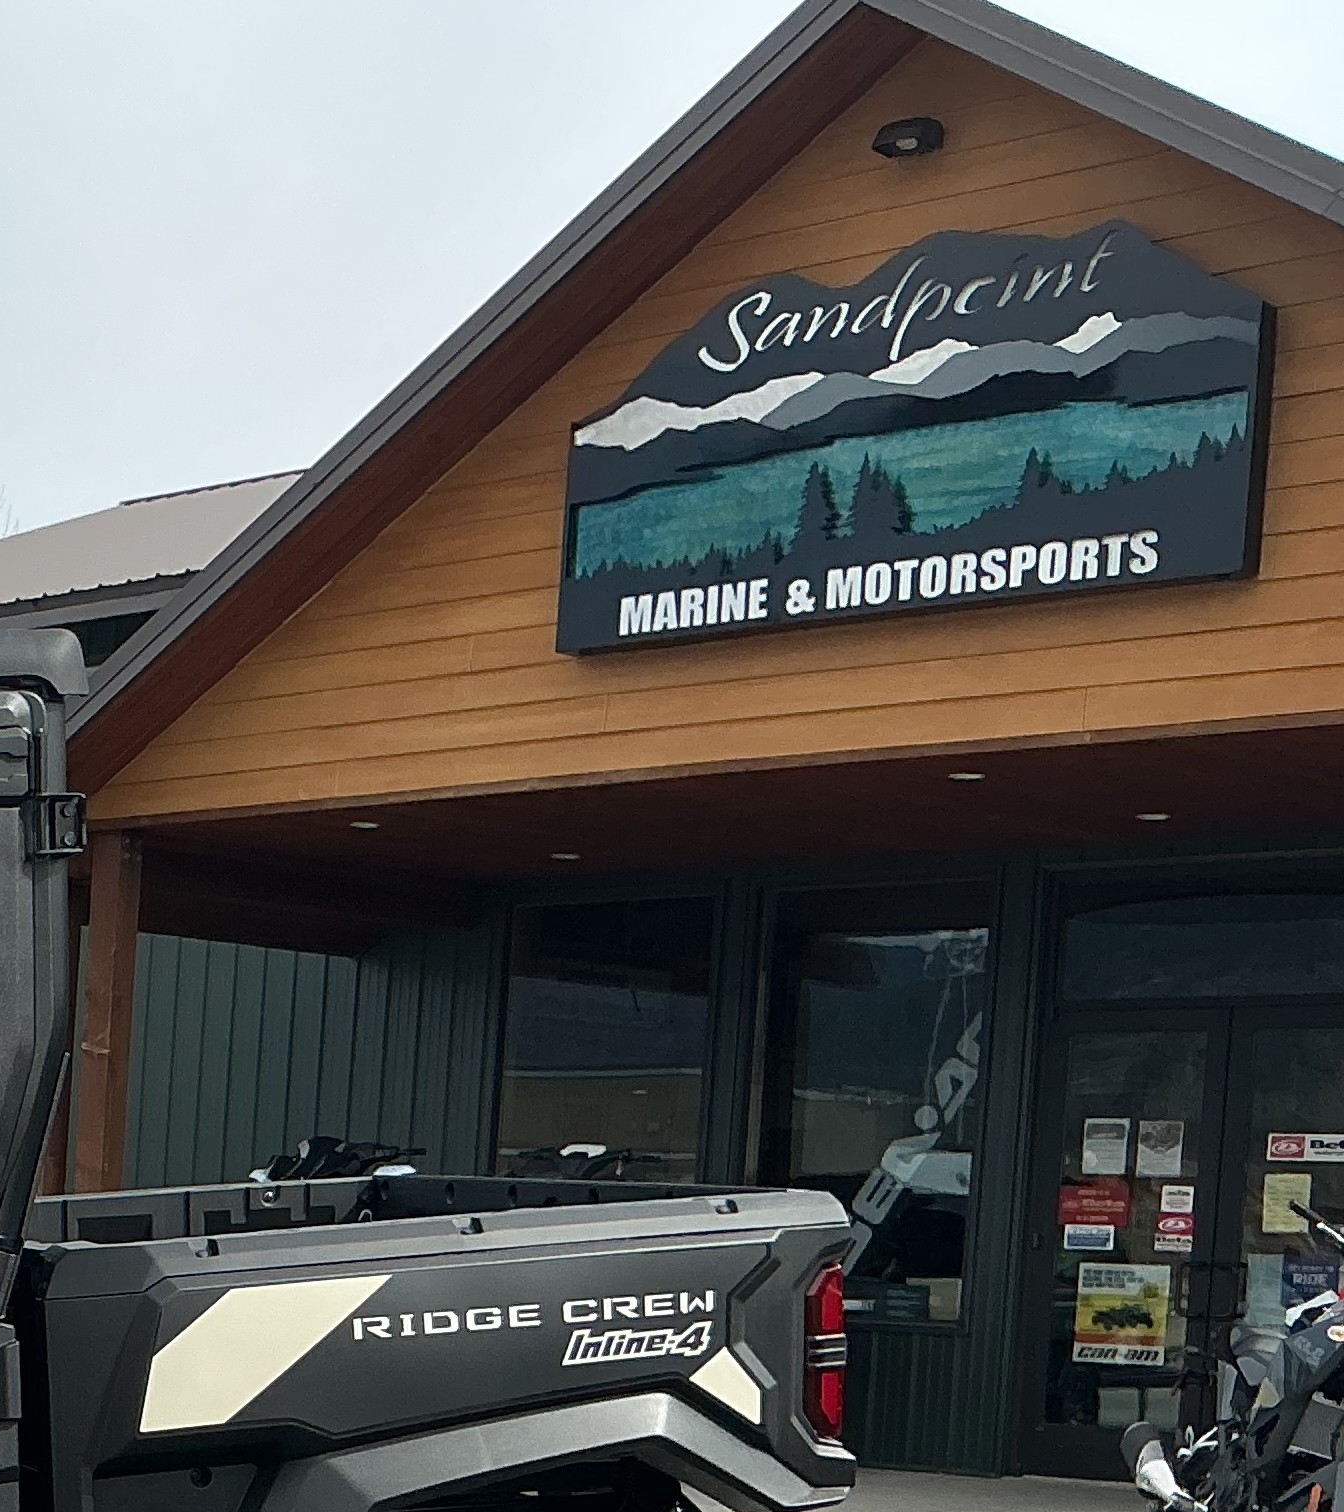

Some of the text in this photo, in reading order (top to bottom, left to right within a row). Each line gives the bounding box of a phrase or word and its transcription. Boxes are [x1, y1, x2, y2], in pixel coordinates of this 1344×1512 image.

[698, 230, 1119, 373] Sandpoint
[618, 530, 1160, 638] MARINE & MOTORSPORTS
[352, 1289, 716, 1341] RIDGE CREW
[562, 1320, 714, 1367] Inline-4
